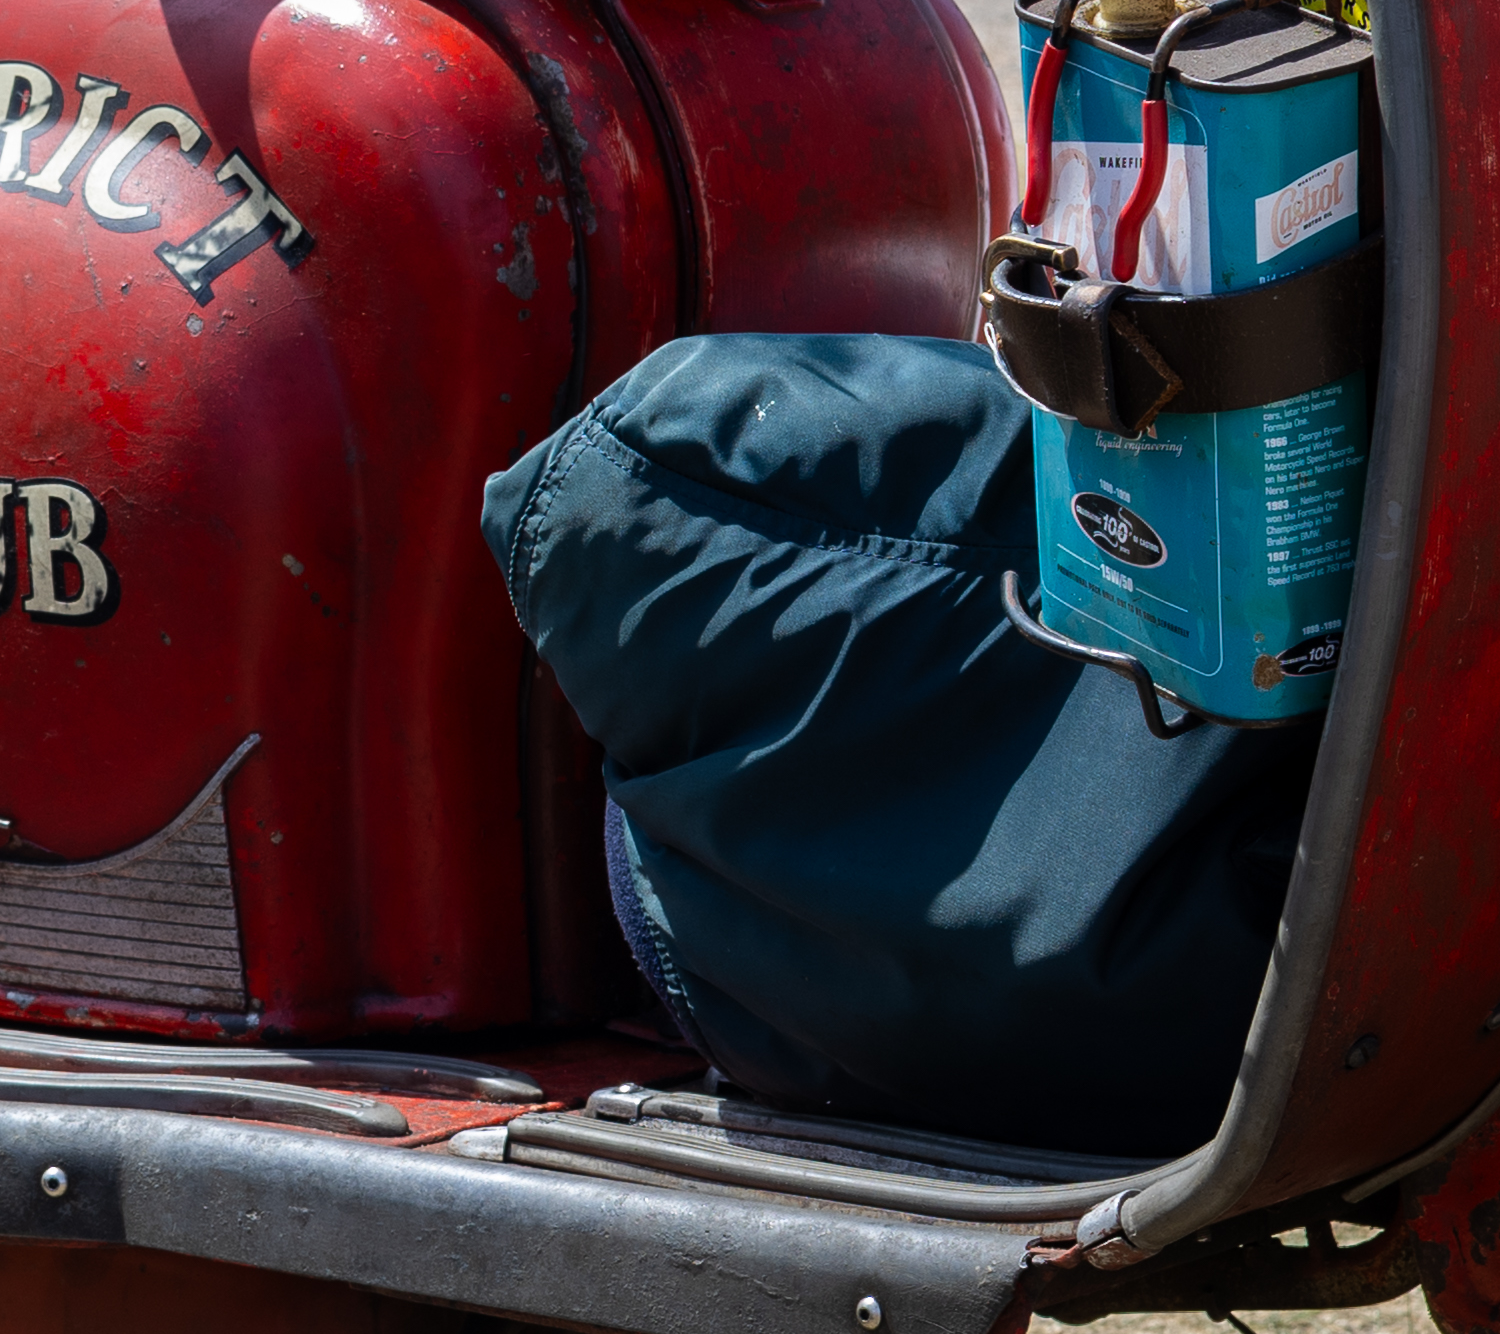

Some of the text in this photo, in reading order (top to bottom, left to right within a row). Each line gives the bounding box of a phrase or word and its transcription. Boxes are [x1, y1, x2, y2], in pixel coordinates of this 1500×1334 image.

[1099, 156, 1143, 169] WAKEFI
[1270, 161, 1345, 249] Castrol
[1284, 408, 1301, 418] later
[1311, 399, 1336, 411] become
[1263, 421, 1293, 433] Formula
[1298, 430, 1322, 443] George
[1264, 439, 1333, 461] broke several World
[1264, 458, 1305, 473] Motorcycle
[1306, 451, 1327, 465] Speed
[1265, 486, 1285, 496] Nero
[1300, 494, 1323, 506] Nelson
[1265, 515, 1283, 524] won
[1283, 513, 1297, 521] the
[1297, 505, 1324, 519] Formula
[1103, 514, 1129, 543] 100
[1265, 519, 1314, 535] Championship
[1100, 563, 1134, 593] 15W/50
[1267, 566, 1281, 575] the
[1267, 574, 1291, 588] Speed
[1292, 569, 1316, 582] Record
[1309, 644, 1335, 661] 100
